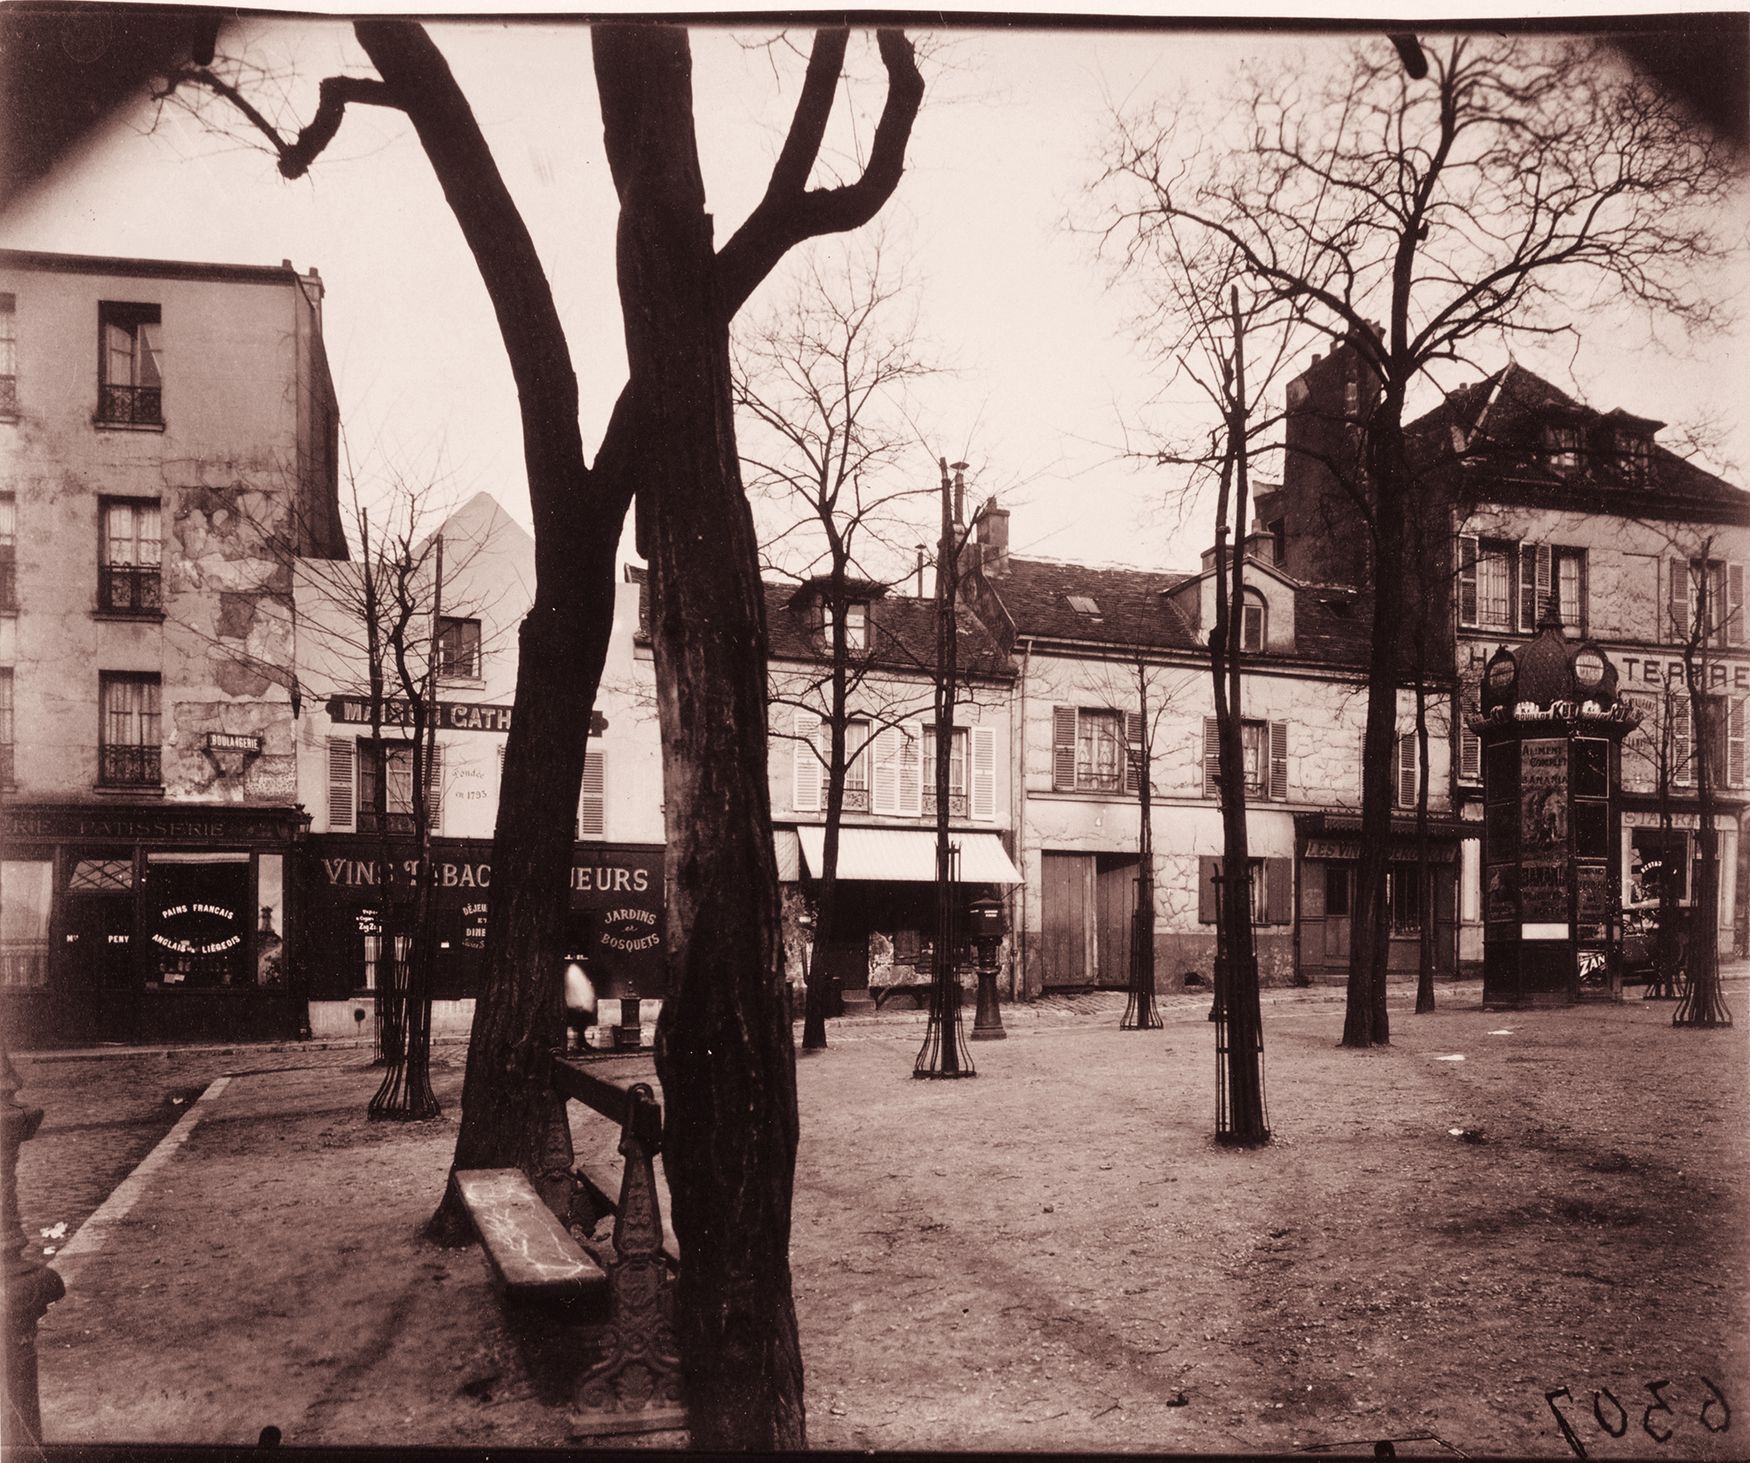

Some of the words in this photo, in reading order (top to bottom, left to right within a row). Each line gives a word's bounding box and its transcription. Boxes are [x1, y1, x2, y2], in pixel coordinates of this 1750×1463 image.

[162, 904, 188, 919] PAINS
[604, 908, 656, 925] JARDINS
[108, 935, 129, 944] PENY
[466, 928, 486, 937] DINE
[151, 933, 187, 953] ANGLAIS
[600, 933, 660, 953] BOSQUETS
[1579, 955, 1606, 978] ZAN
